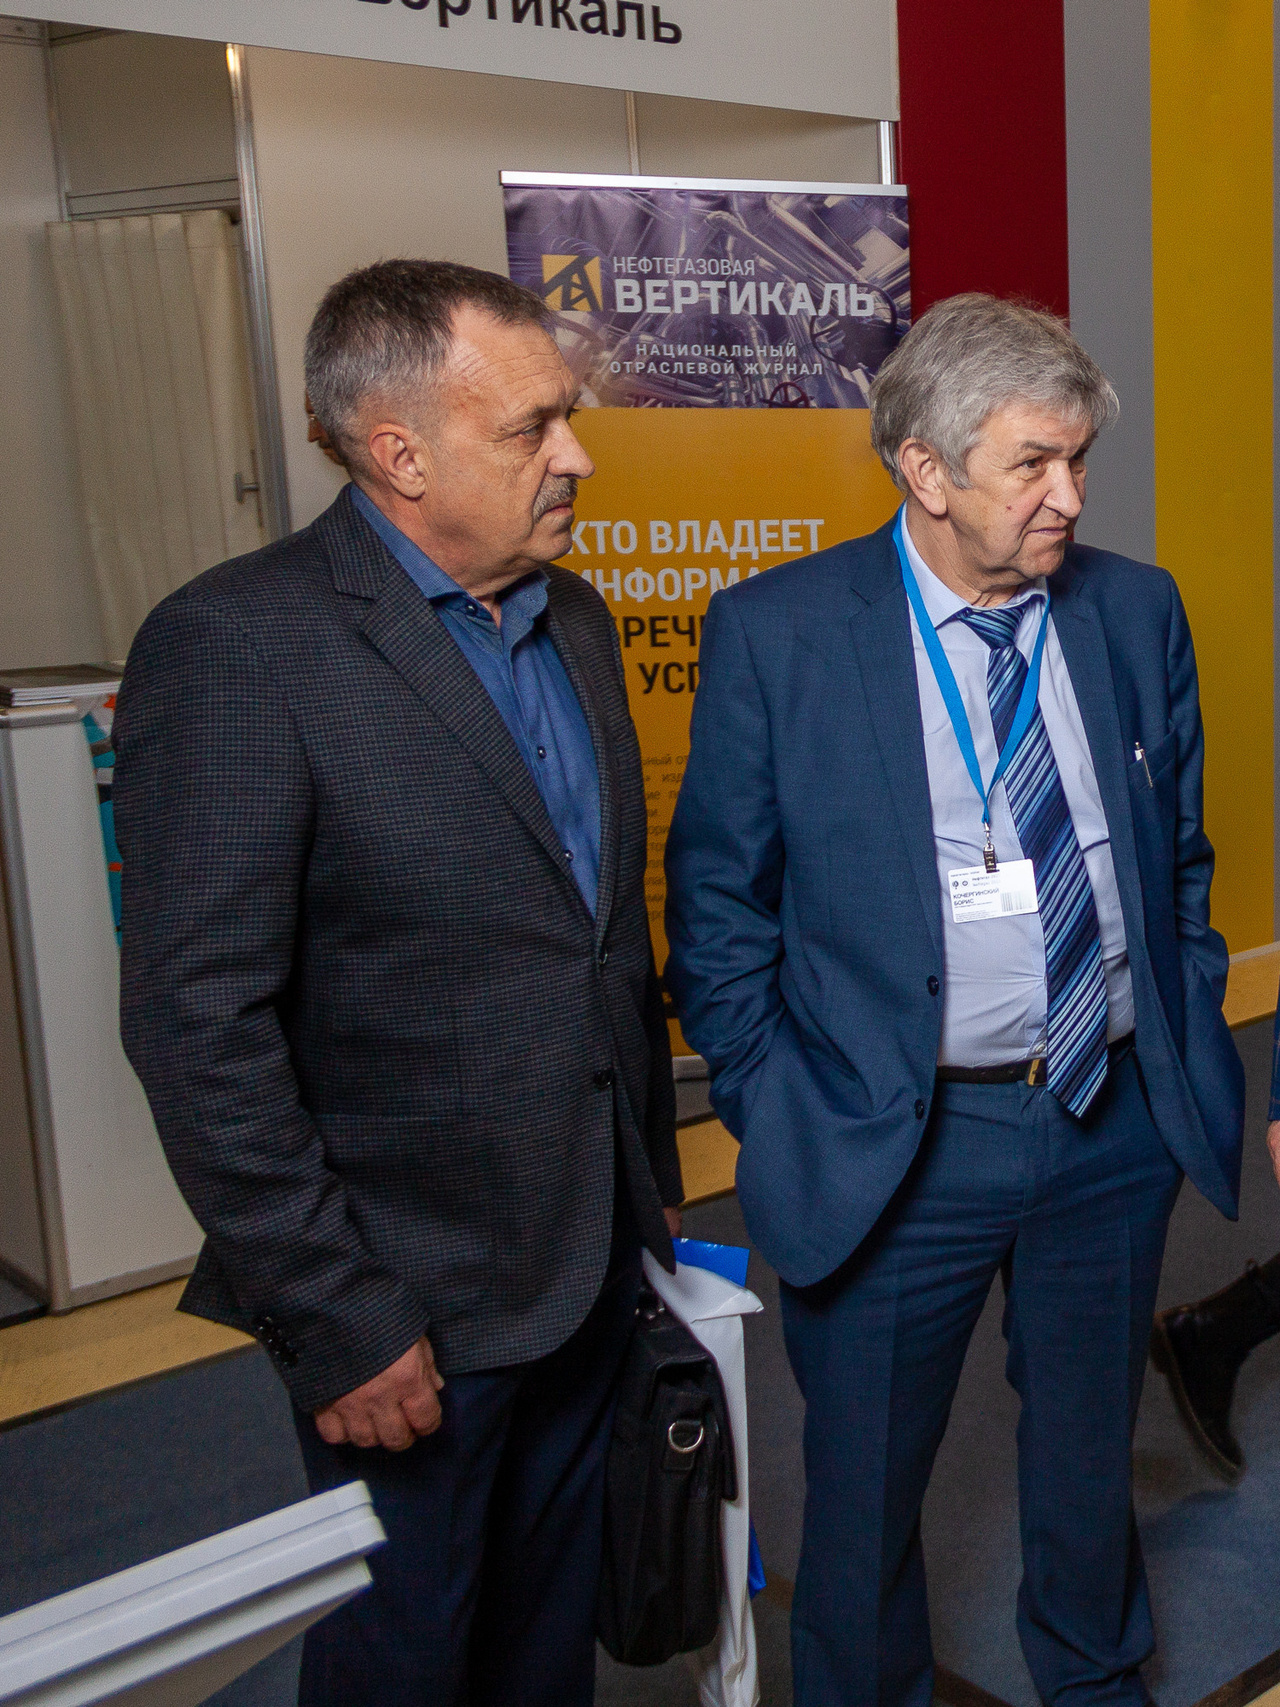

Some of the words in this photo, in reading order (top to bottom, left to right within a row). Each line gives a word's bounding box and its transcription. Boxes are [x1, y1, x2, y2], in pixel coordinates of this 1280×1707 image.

[613, 256, 755, 276] НЕФТЕГАЗОВАЯ
[615, 278, 875, 317] ВЕРТИКАЛЬ
[636, 341, 797, 358] НАЦИОНАЛЬНЫЙ
[610, 360, 735, 375] ОТРАСЛЕВОЙ
[744, 362, 823, 375] ЖУРНАЛ
[568, 519, 638, 555] КТО
[650, 518, 825, 560] ВЛАДЕЕТ
[953, 898, 975, 906] БОРИС
